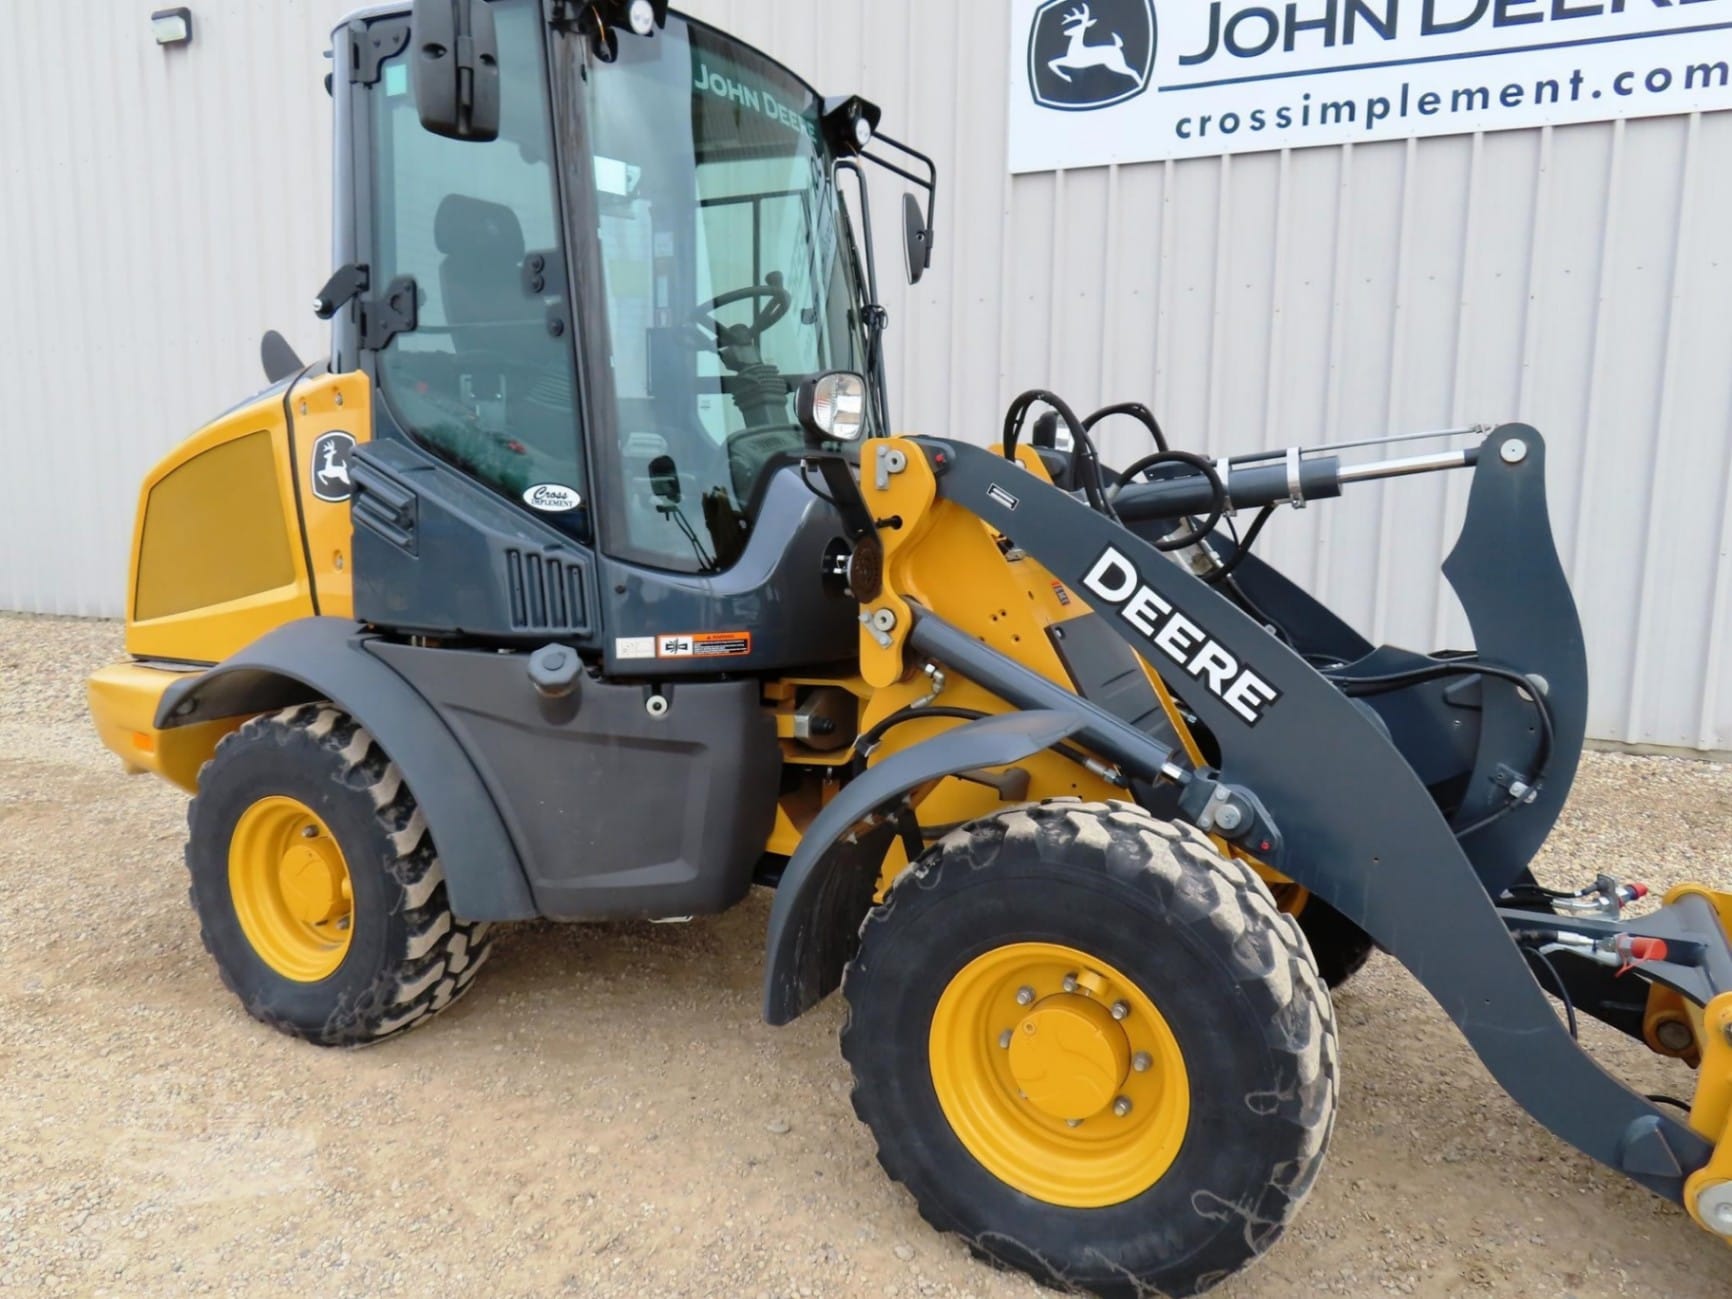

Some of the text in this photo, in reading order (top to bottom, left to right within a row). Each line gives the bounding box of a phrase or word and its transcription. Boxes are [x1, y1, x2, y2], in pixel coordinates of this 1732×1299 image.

[1178, 0, 1398, 65] JOHN
[694, 64, 760, 112] JOHN
[1175, 61, 1729, 139] crossimplement.com
[533, 486, 568, 500] Cross
[1083, 546, 1278, 723] DEERE
